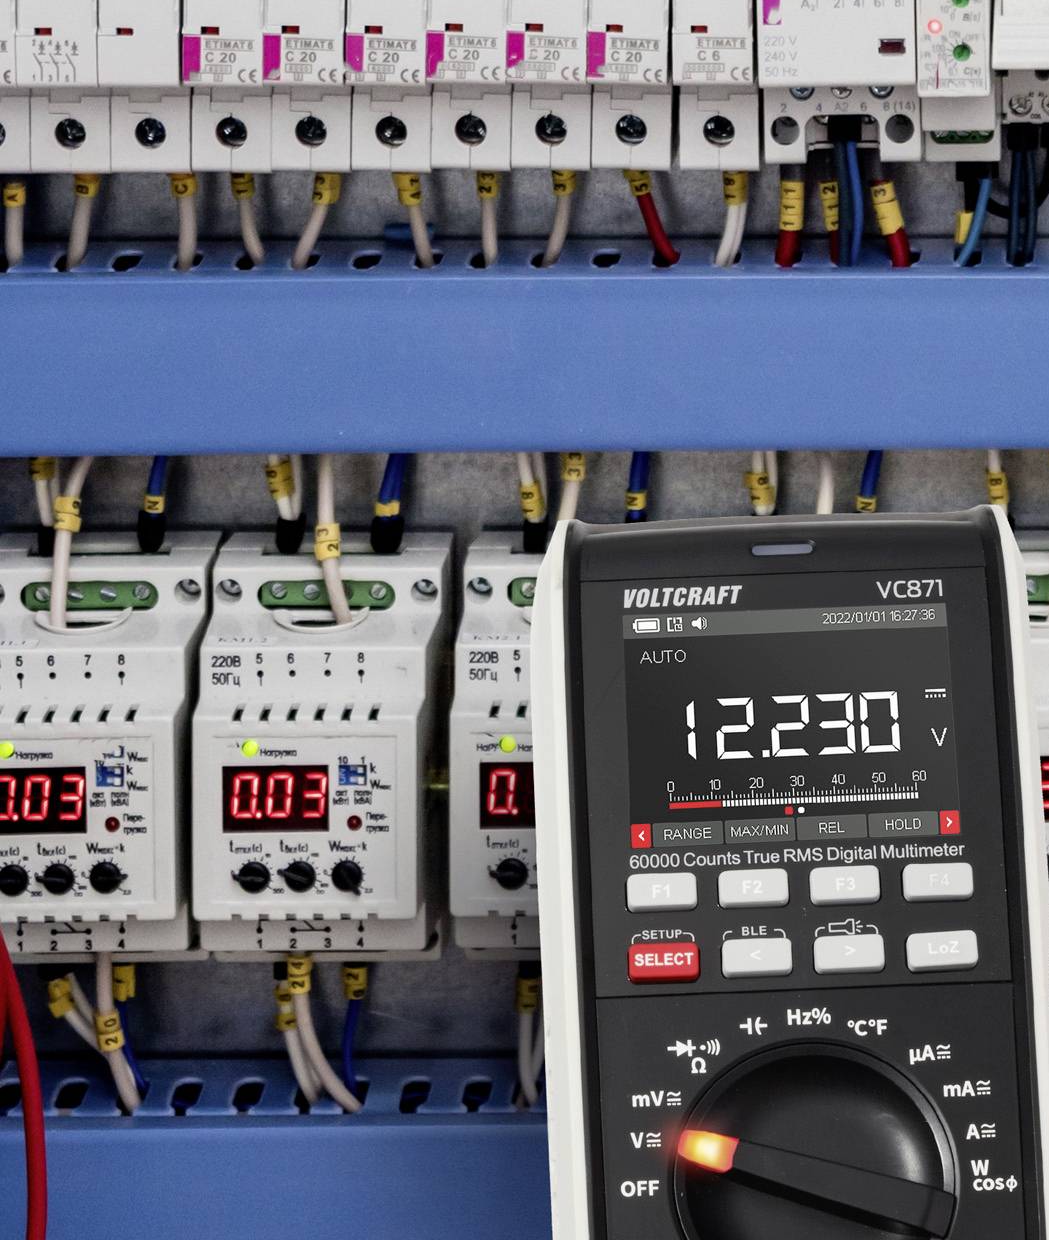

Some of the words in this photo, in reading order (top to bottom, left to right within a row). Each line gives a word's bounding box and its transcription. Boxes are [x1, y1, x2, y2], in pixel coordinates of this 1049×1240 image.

[285, 51, 294, 63] C
[300, 51, 317, 63] 20
[624, 585, 742, 609] VOLTCRAFT
[876, 579, 944, 600] VC871
[822, 610, 886, 625] 2022/01/01
[888, 609, 936, 622] 16:27:36
[640, 649, 687, 664] AUTO
[685, 690, 901, 760] 12.230
[930, 727, 948, 747] V
[666, 781, 675, 793] 0
[709, 779, 721, 791] 10
[749, 777, 764, 789] 20
[790, 775, 805, 787] 30
[831, 773, 846, 785] 40
[871, 771, 887, 783] 50
[911, 770, 927, 782] 60
[231, 773, 328, 820] 0.03
[730, 823, 790, 838] MAX/MIN
[818, 821, 845, 834] REL
[884, 818, 922, 831] HOLD
[663, 827, 712, 841] RANGE
[629, 853, 681, 870] 60000
[683, 850, 741, 867] Counts
[743, 849, 781, 865] True
[783, 847, 823, 862] RMS
[827, 844, 878, 865] Digital
[880, 842, 965, 860] Multimeter
[742, 880, 763, 894] F2
[835, 877, 856, 892] F3
[929, 873, 950, 887] F4
[652, 884, 671, 899] F1
[641, 929, 682, 941] SETUP
[741, 925, 767, 937] BLE
[928, 940, 960, 955] LoZ
[634, 952, 694, 967] SELECT
[786, 1008, 832, 1027] Hz%
[970, 1160, 990, 1176] W
[620, 1181, 660, 1197] OFF
